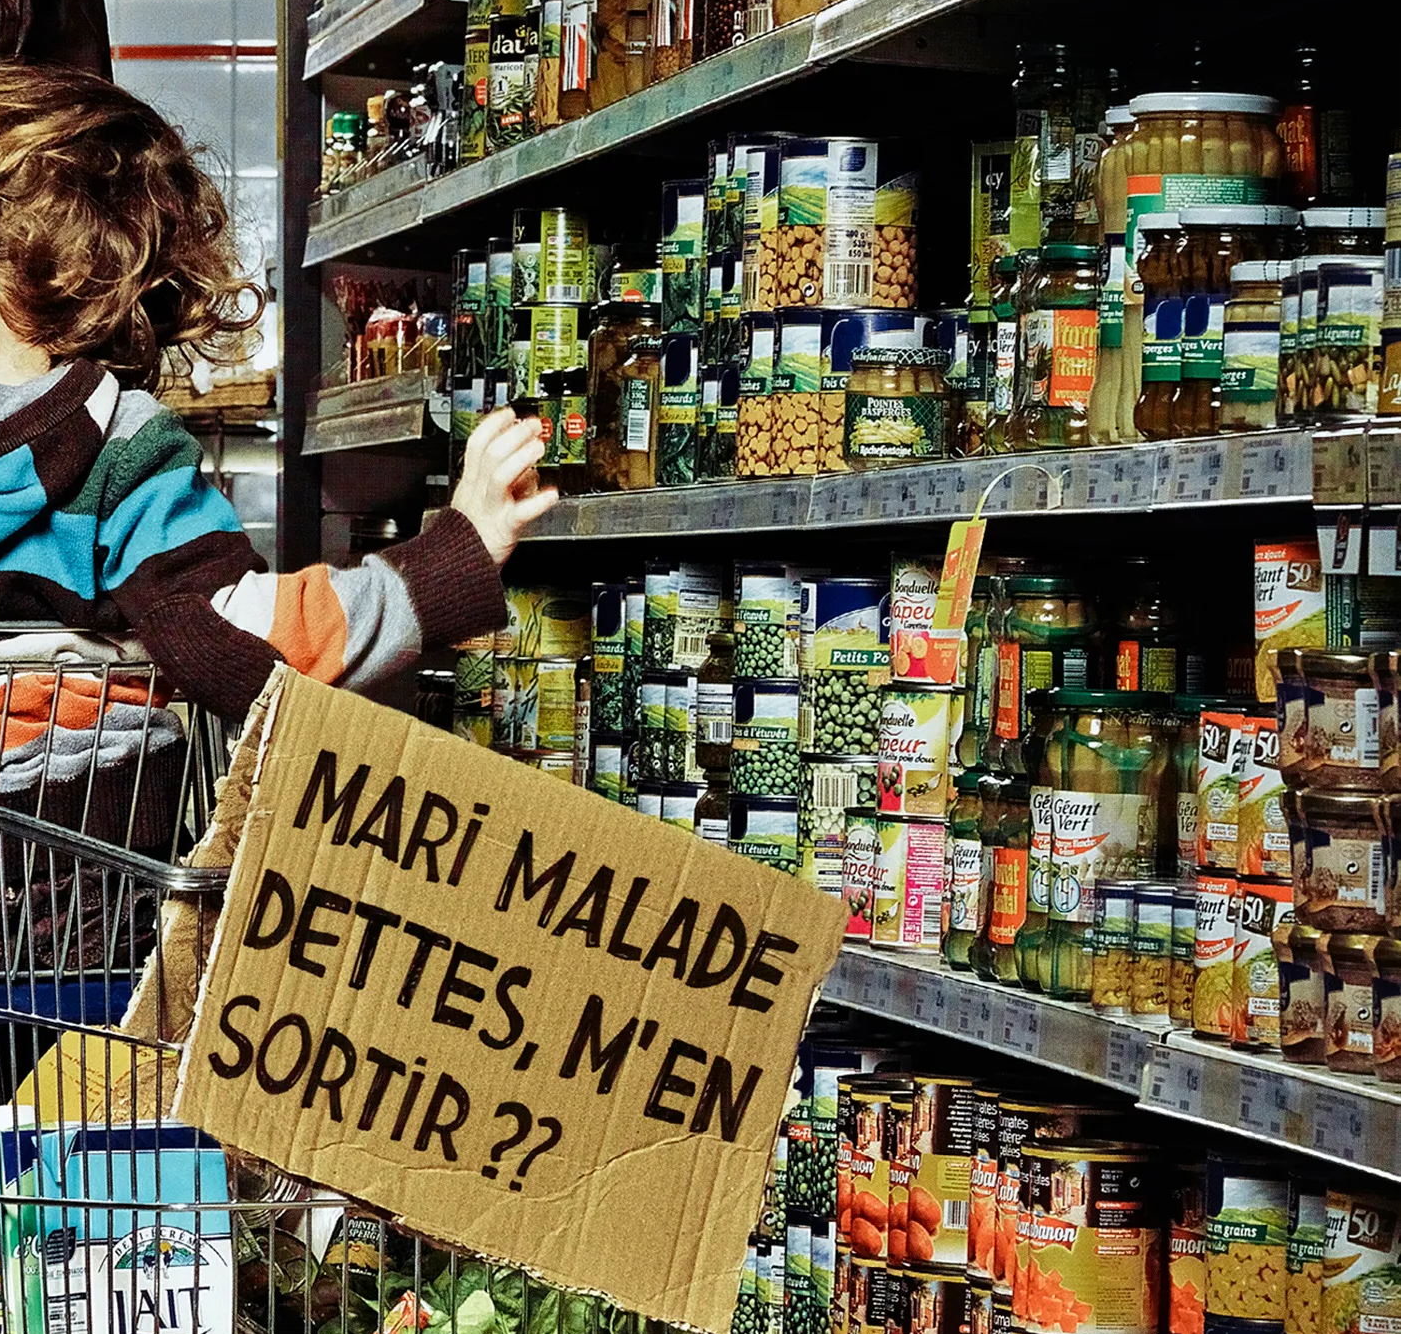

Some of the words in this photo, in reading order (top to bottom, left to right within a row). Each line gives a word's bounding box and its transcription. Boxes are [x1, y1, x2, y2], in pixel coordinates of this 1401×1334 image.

[1288, 563, 1311, 586] 50
[895, 579, 940, 596] Bonduelle
[832, 651, 868, 664] Petits
[749, 727, 788, 739] l'étuvée
[1054, 798, 1100, 816] Géant
[1059, 817, 1090, 831] Vert
[495, 829, 799, 1013] MALADE
[244, 869, 538, 1069] DETTES,
[560, 996, 762, 1142] M'EN
[482, 1101, 562, 1192] ??
[1223, 1225, 1257, 1238] grains
[1348, 1208, 1379, 1240] 50
